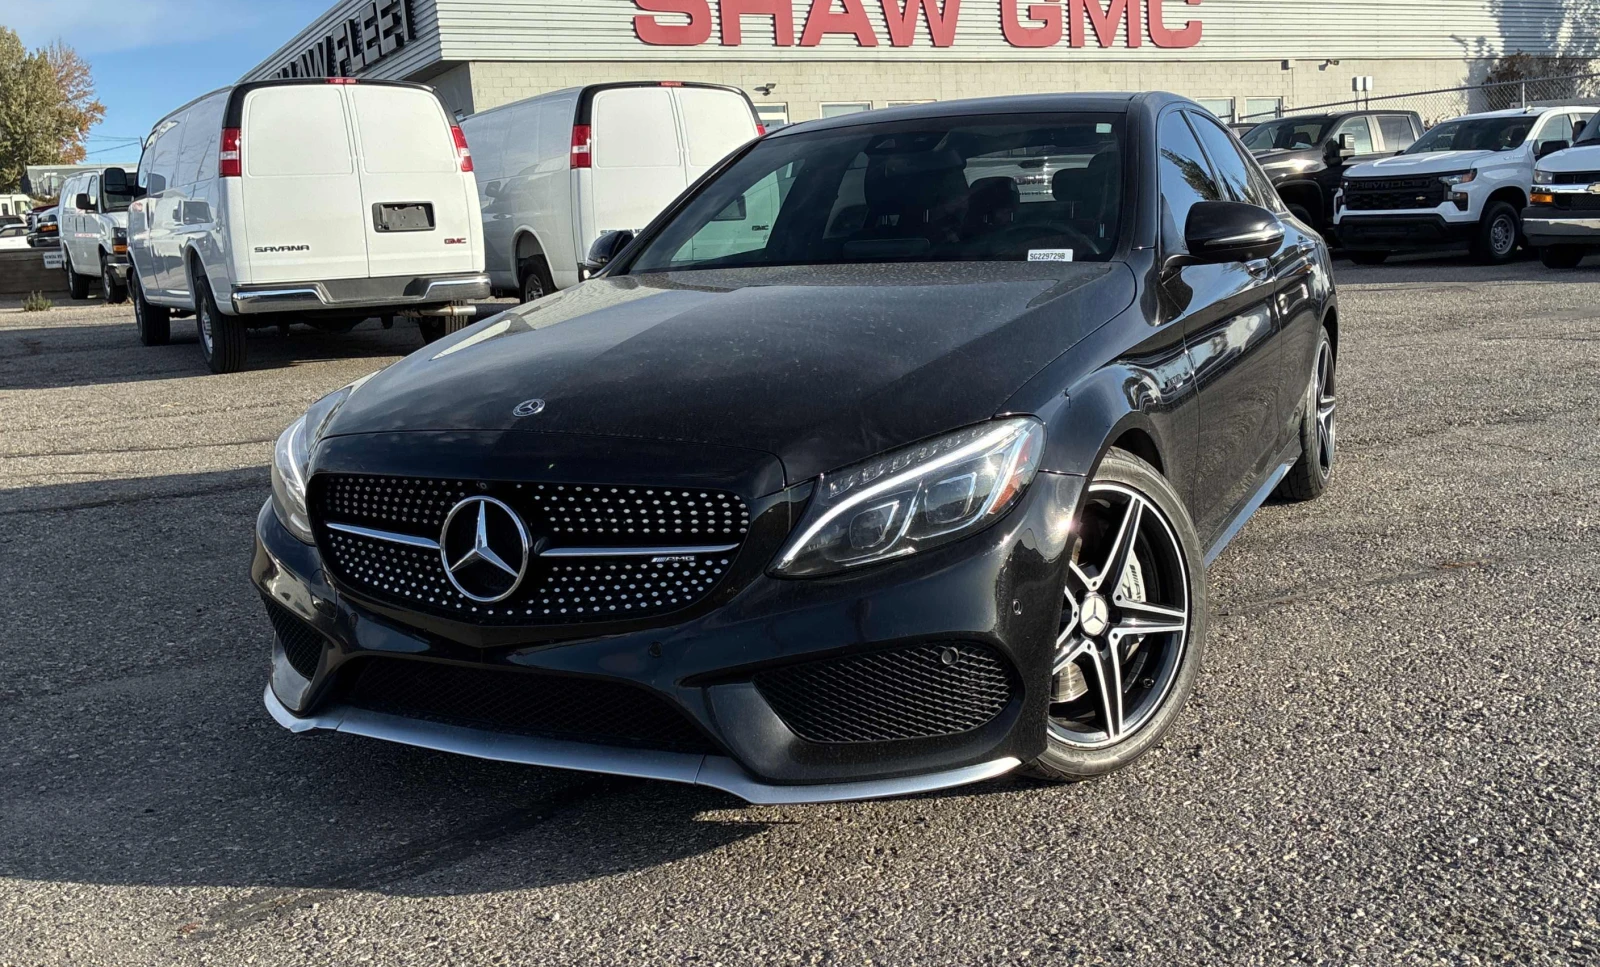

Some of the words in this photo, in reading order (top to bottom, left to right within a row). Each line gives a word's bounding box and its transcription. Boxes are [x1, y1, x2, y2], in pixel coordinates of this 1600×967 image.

[634, 0, 961, 46] SHAW
[1002, 0, 1203, 48] GMC
[269, 36, 331, 78] AW
[254, 245, 310, 253] SAVANA
